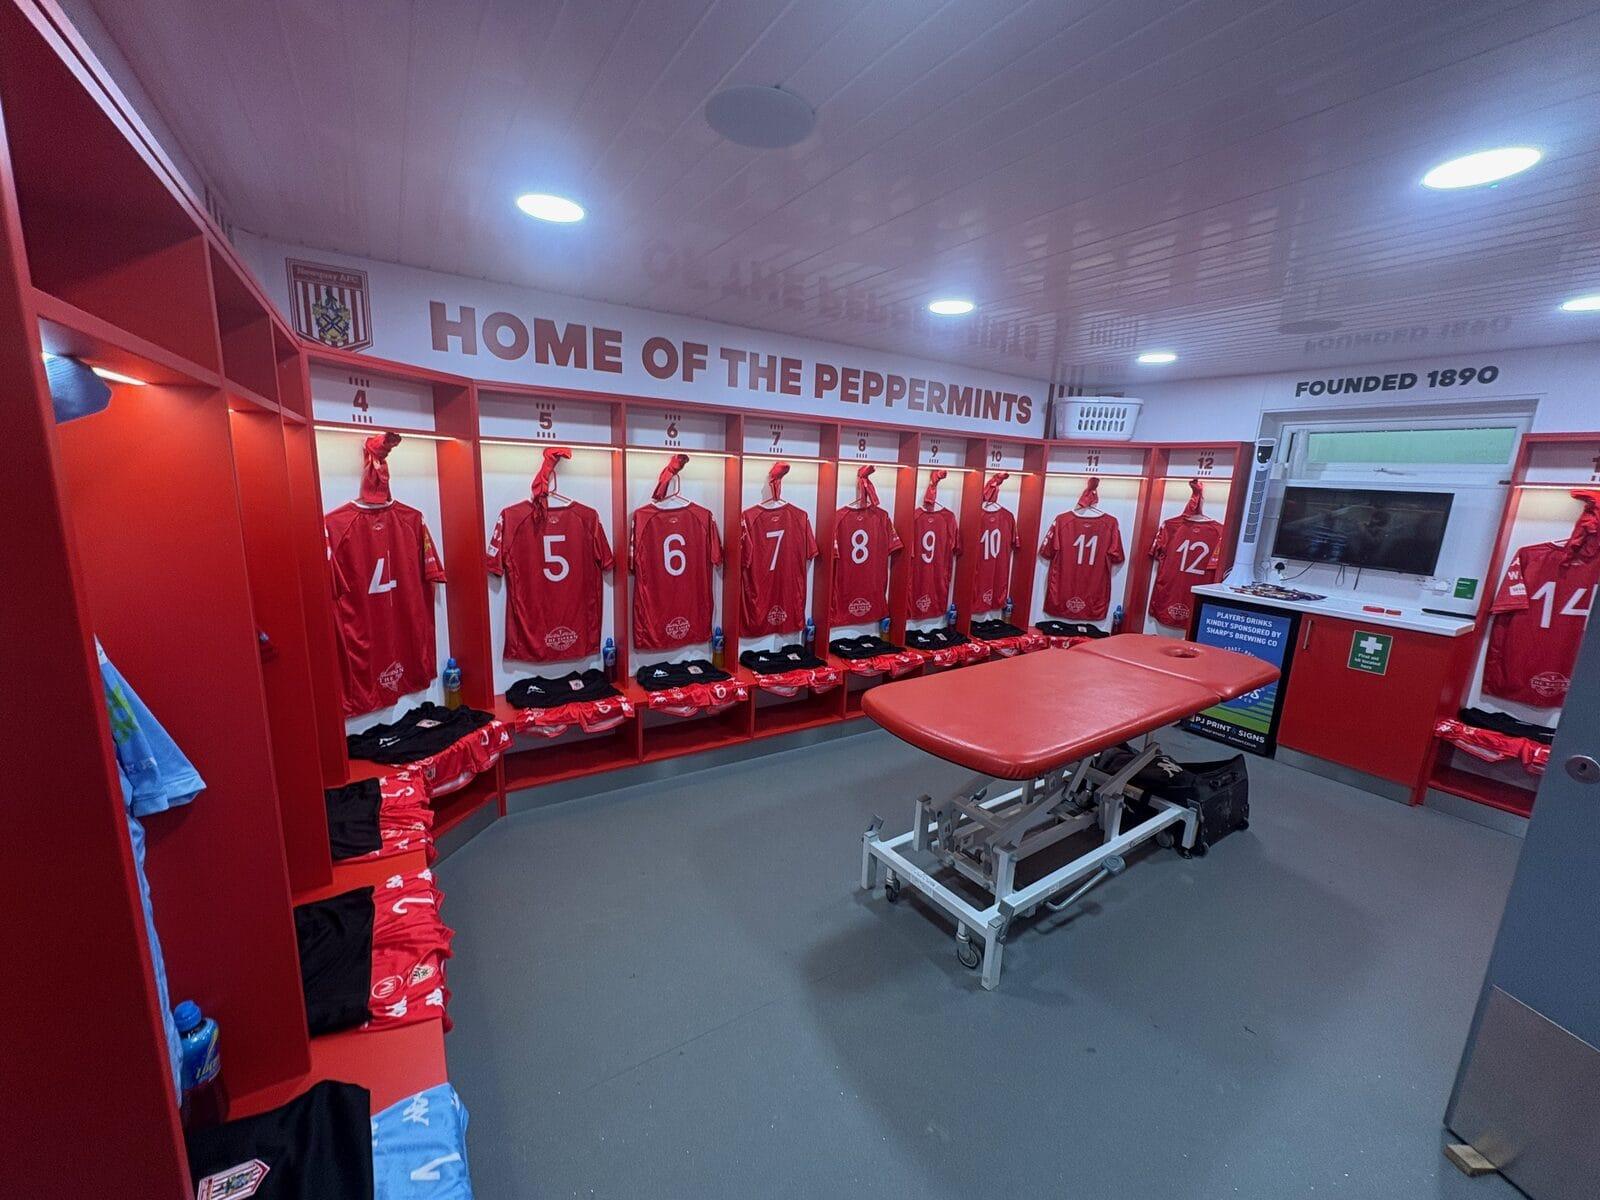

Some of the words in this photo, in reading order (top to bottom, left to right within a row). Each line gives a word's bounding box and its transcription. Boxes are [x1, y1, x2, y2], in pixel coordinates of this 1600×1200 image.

[429, 300, 623, 374] HOME
[641, 337, 708, 383] OF
[719, 347, 803, 395] THE
[813, 363, 1033, 425] PEPPERMINTS
[1295, 372, 1418, 397] FOUNDED
[1427, 365, 1500, 388] 1890
[352, 389, 369, 412] 4
[539, 411, 553, 430] 5
[667, 421, 678, 439] 6
[771, 431, 781, 446] 7
[858, 438, 866, 452] 8
[931, 444, 938, 458] 9
[991, 450, 1002, 463] 10
[1086, 455, 1099, 467] 11
[1197, 457, 1214, 469] 12
[766, 529, 785, 572] 7
[851, 529, 869, 565] 8
[920, 530, 936, 565] 9
[980, 528, 1001, 559] 10
[1072, 534, 1098, 565] 11
[543, 534, 570, 582] 5
[663, 534, 687, 577] 6
[1176, 539, 1210, 576] 12
[1530, 581, 1598, 631] 14
[1206, 618, 1229, 628] KINDLY
[1230, 623, 1270, 637] SPONSORED
[1271, 631, 1282, 639] BY
[1216, 611, 1245, 622] PLAYERS
[1246, 617, 1273, 628] DRINKS
[1206, 627, 1234, 638] SHARP'S
[1234, 633, 1266, 645] BREWING
[714, 684, 727, 699] 6
[594, 701, 612, 714] 5
[1195, 716, 1205, 724] PJ
[1206, 720, 1232, 732] PRINT
[1238, 730, 1265, 744] SIGNS
